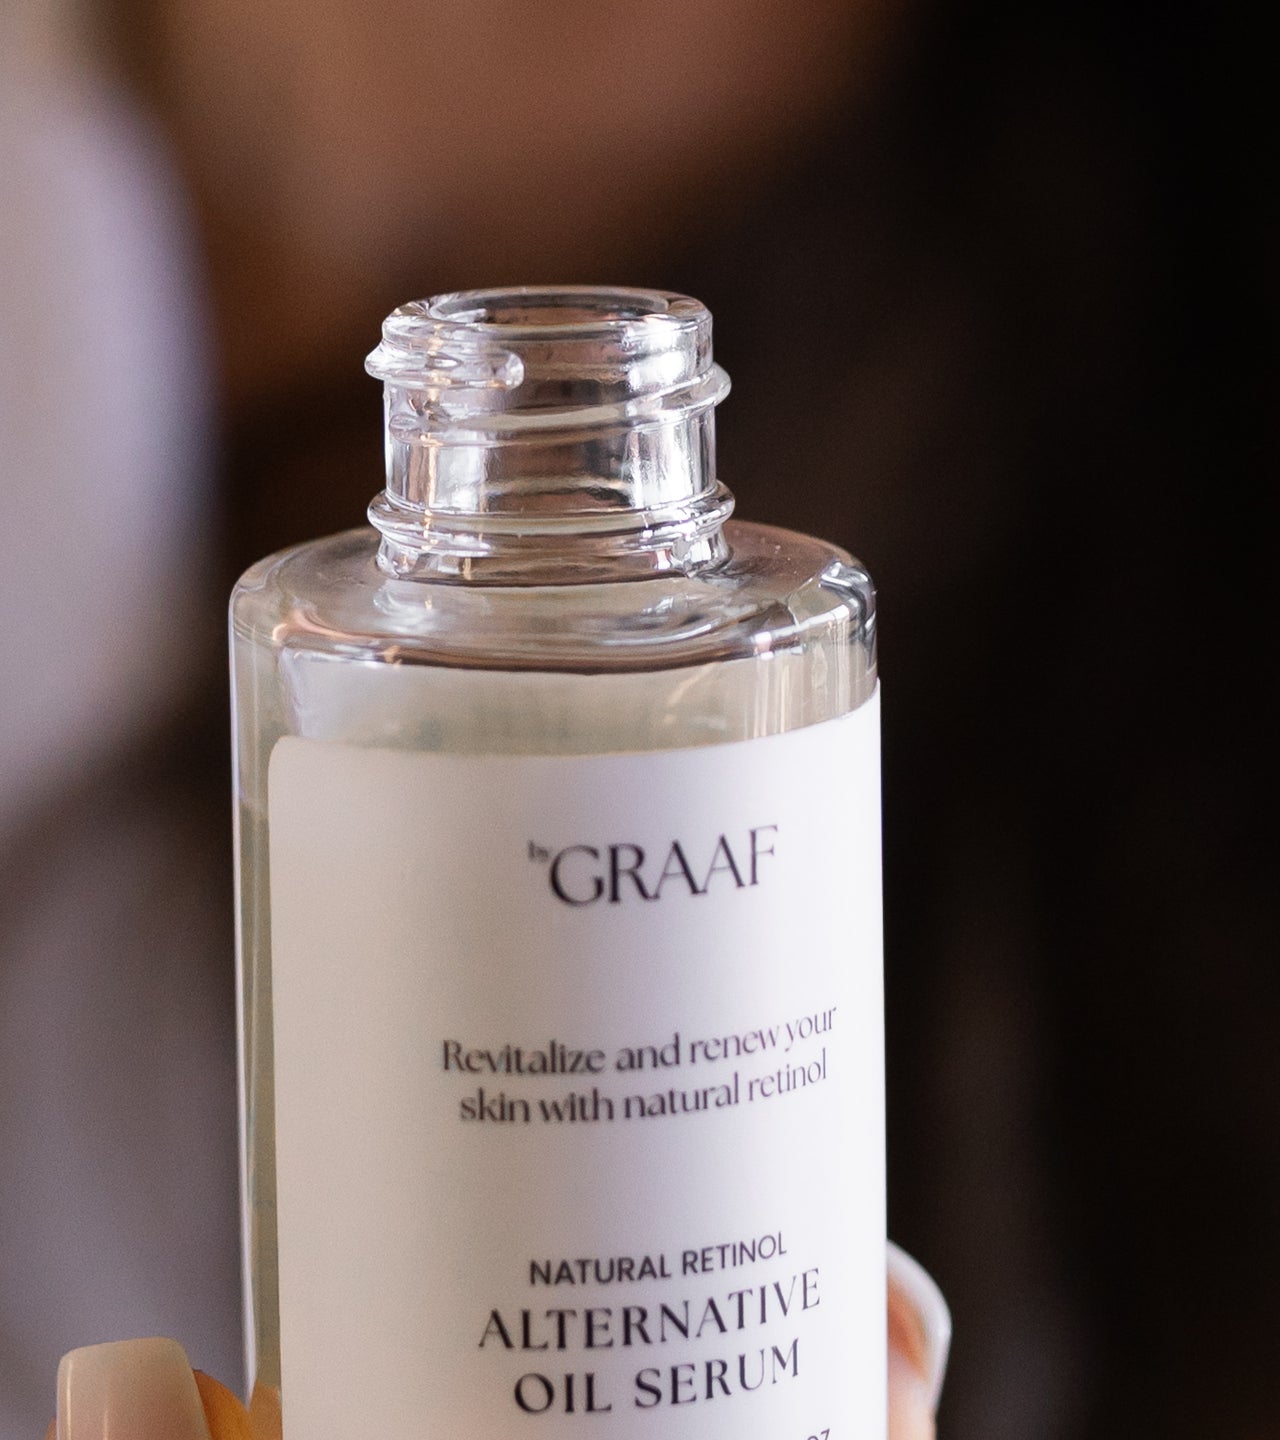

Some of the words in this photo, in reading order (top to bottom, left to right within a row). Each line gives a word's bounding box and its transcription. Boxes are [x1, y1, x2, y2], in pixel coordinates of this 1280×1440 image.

[548, 824, 779, 908] GRAAF
[442, 1038, 607, 1075] Revitalize
[615, 1031, 681, 1073] and
[688, 1024, 780, 1065] renew
[783, 1005, 838, 1052] your
[459, 1086, 531, 1123] skin
[538, 1086, 616, 1123] with
[623, 1071, 741, 1120] natural
[746, 1046, 829, 1103] retinol
[528, 1253, 672, 1287] NATURAL
[681, 1231, 788, 1276] RETINOL
[477, 1267, 821, 1351] ALTERNATIVE
[513, 1371, 613, 1414] OIL
[633, 1336, 800, 1410] SERUM
